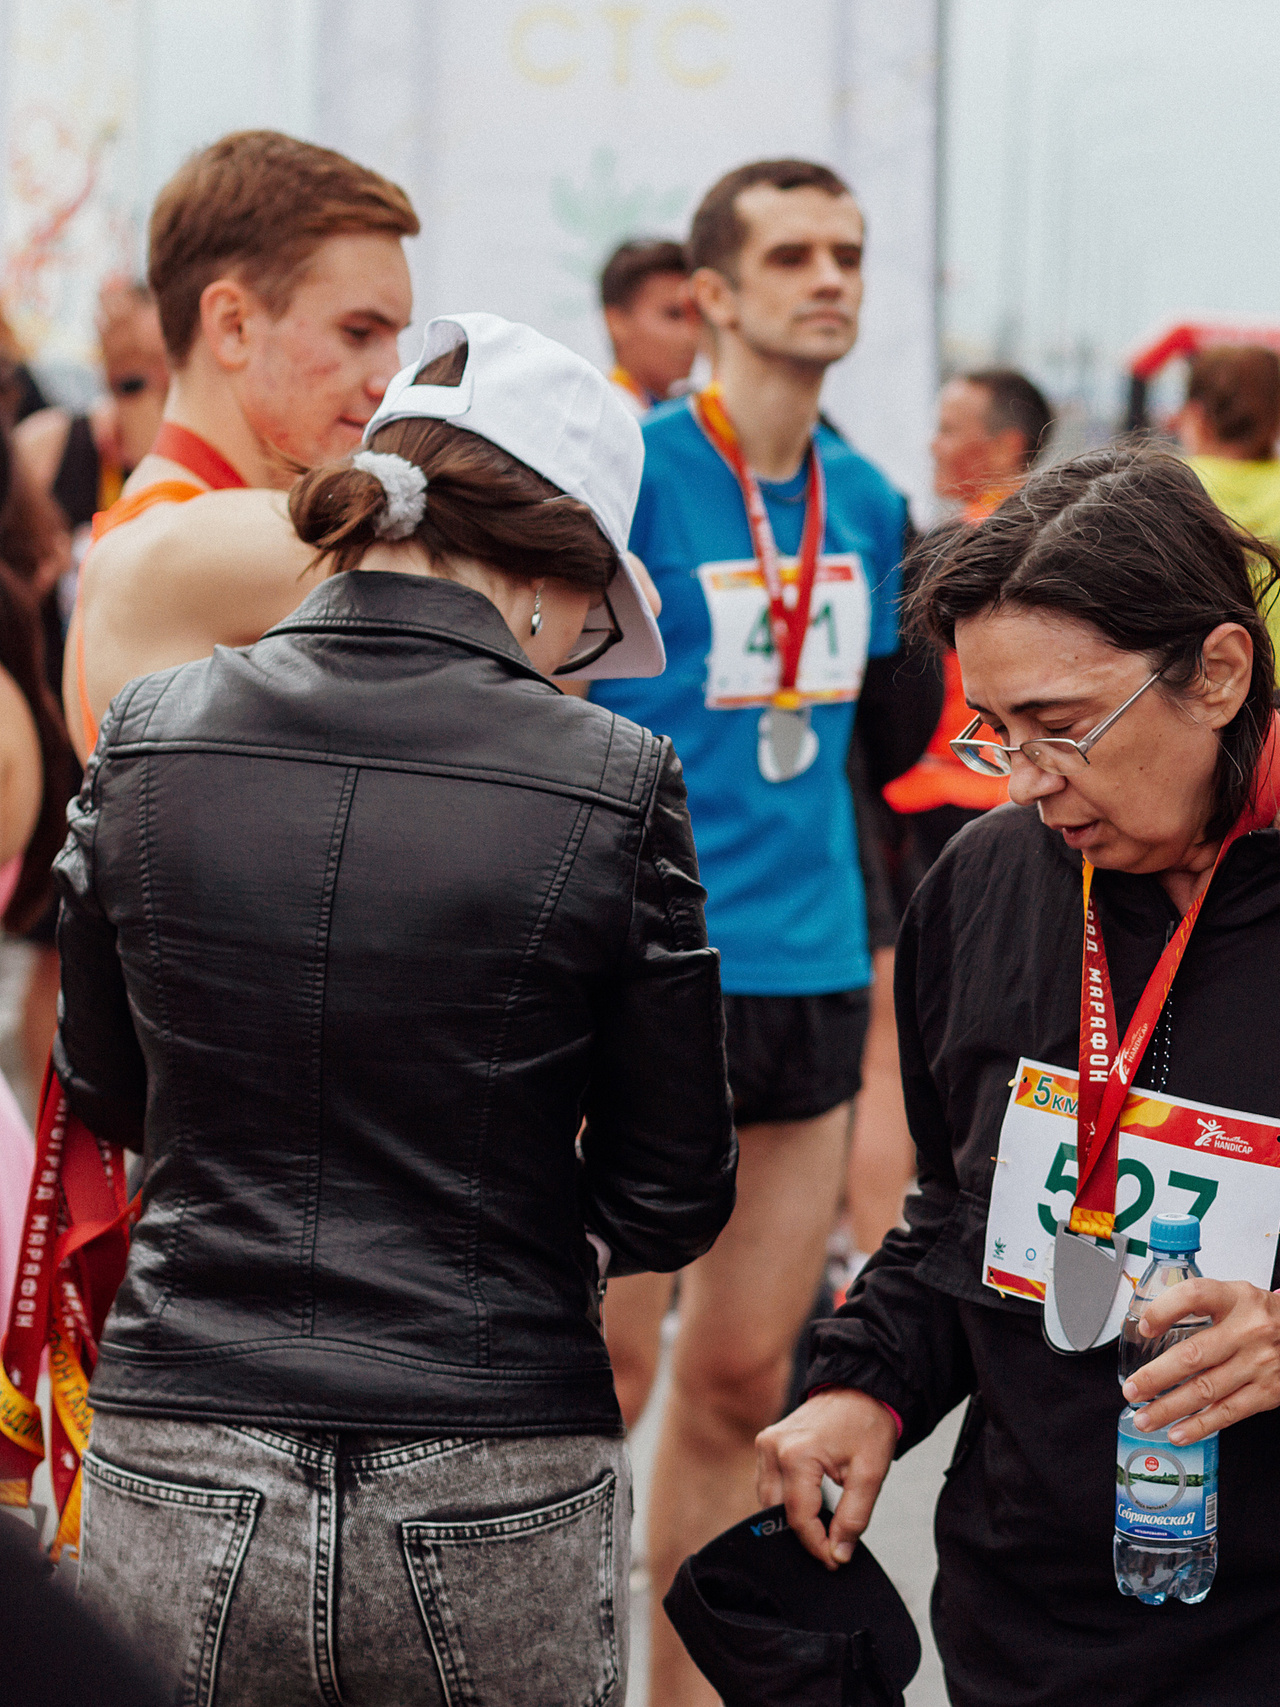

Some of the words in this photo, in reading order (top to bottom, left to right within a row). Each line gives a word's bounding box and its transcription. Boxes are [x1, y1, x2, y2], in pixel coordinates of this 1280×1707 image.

[744, 602, 838, 662] 41
[1088, 967, 1109, 1082] МАРАФОН
[1214, 1140, 1253, 1154] HANDICAP
[1037, 1142, 1219, 1258] 527
